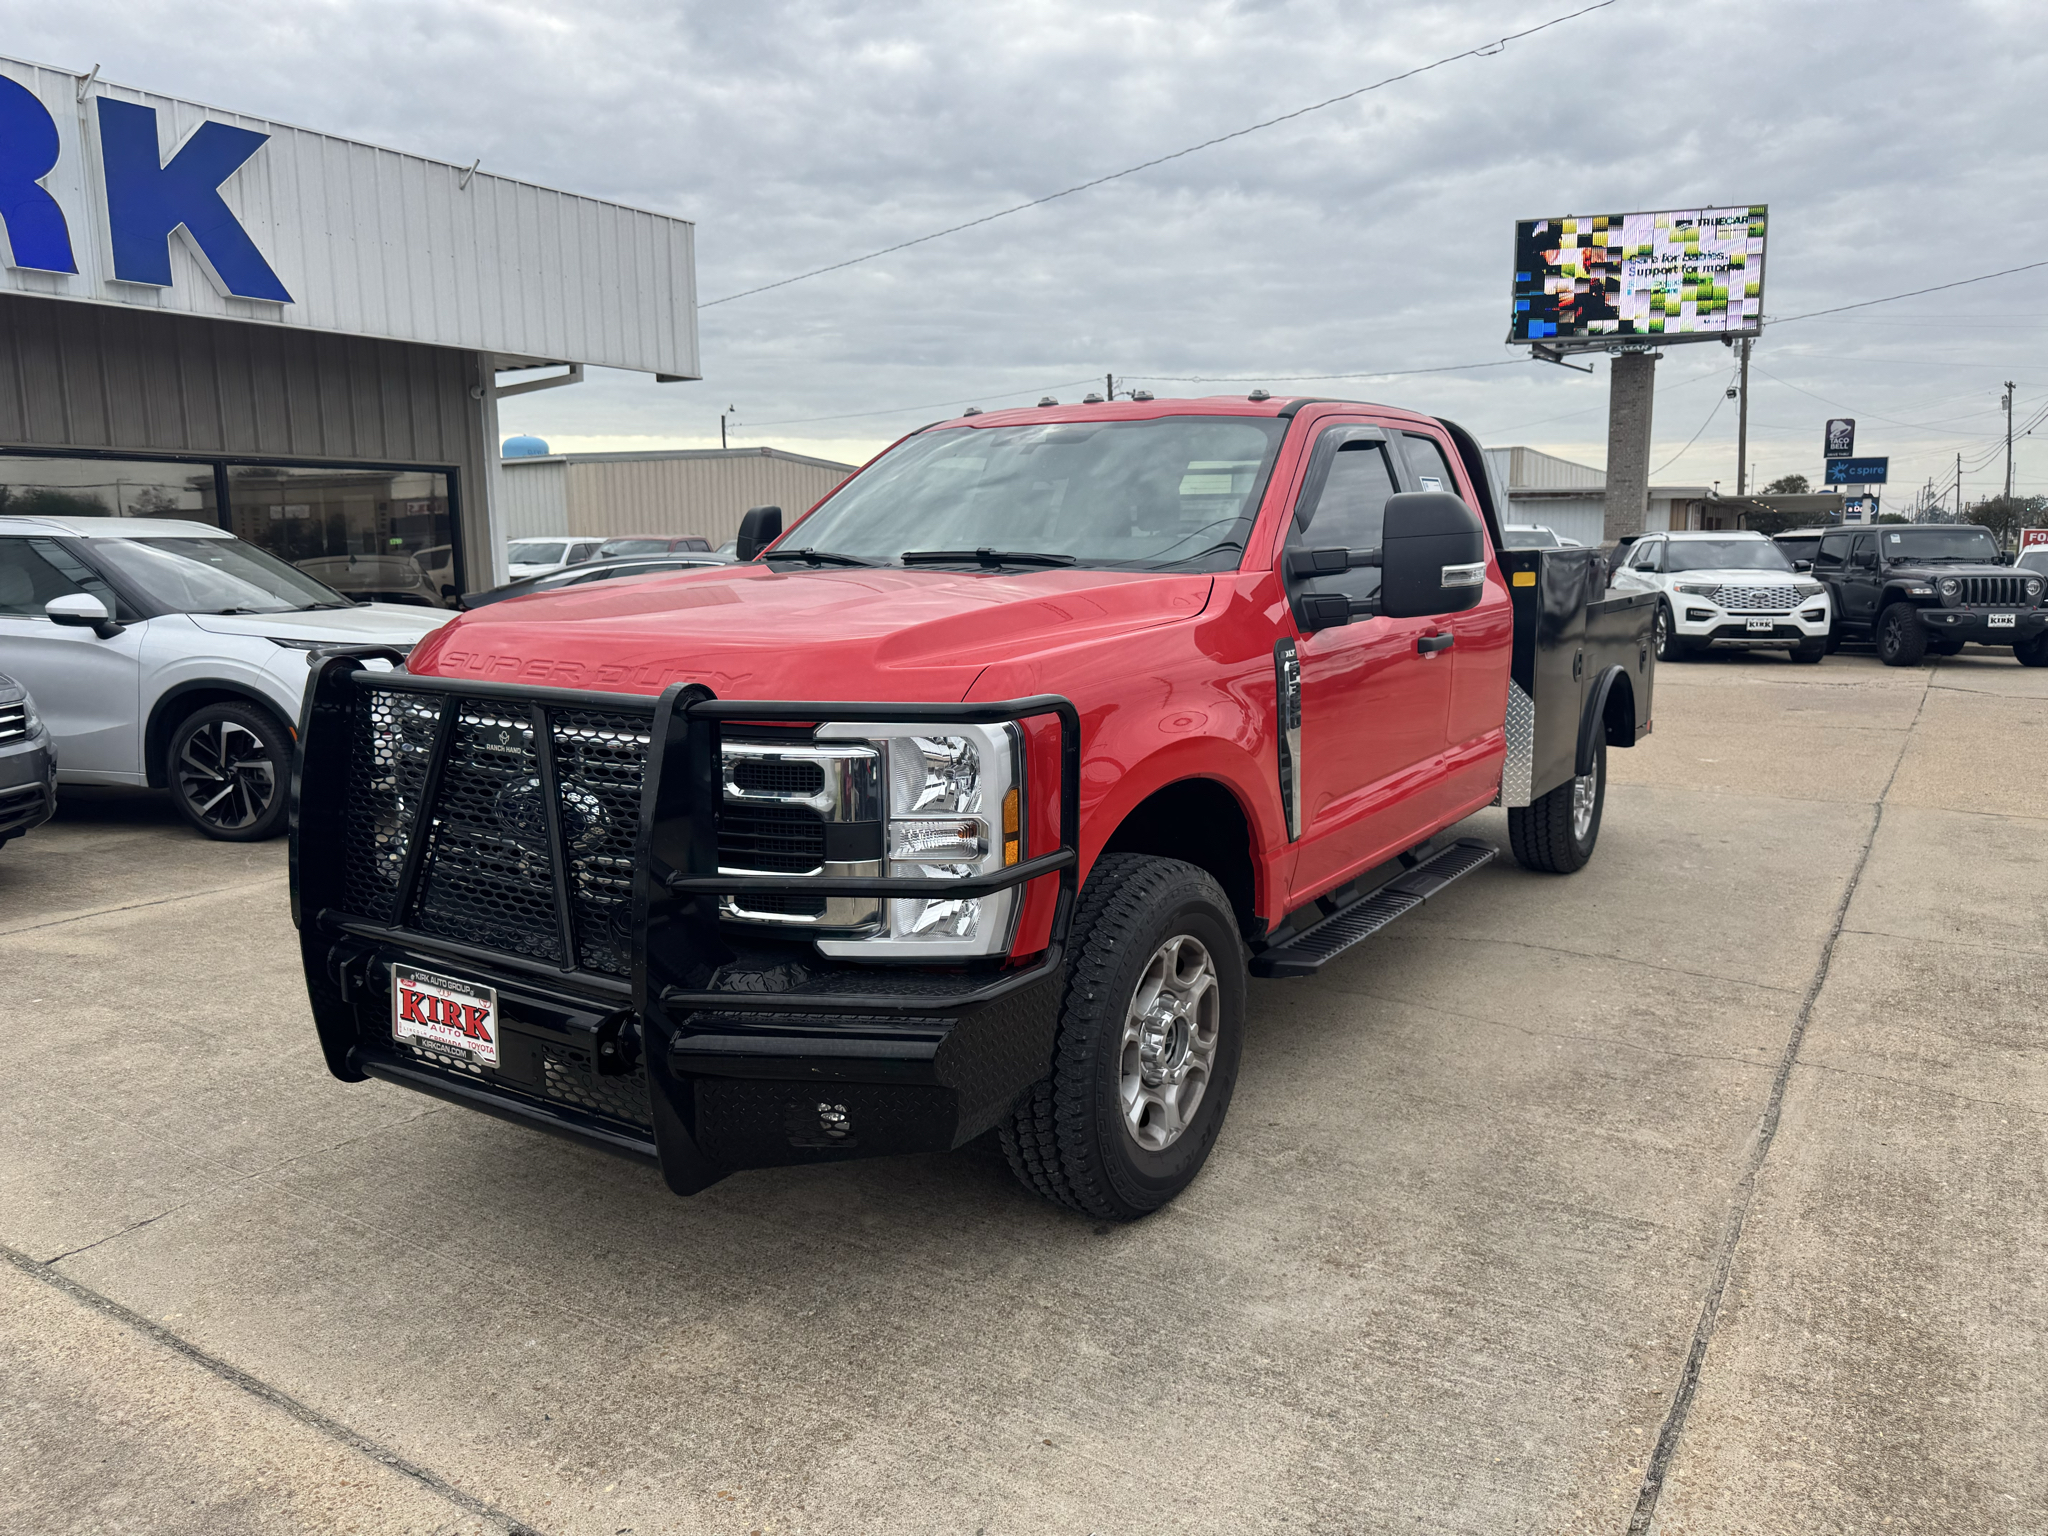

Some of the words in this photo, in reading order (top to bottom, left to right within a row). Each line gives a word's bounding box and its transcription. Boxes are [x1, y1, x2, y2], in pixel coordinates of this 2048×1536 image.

[1661, 253, 1681, 263] for
[1628, 264, 1679, 278] Support
[1681, 263, 1699, 274] for
[1608, 344, 1650, 352] LAMAR
[2028, 532, 2048, 543] FO
[440, 650, 586, 684] SUPER
[591, 663, 753, 693] DUTY
[486, 743, 506, 752] RANCH
[505, 746, 522, 755] HAND
[414, 972, 430, 983] KIRK
[430, 976, 447, 988] AUTO
[447, 981, 471, 994] GROUP
[400, 987, 493, 1043] KIRK
[430, 1024, 462, 1037] AUTO
[467, 1040, 495, 1055] TOYOTA
